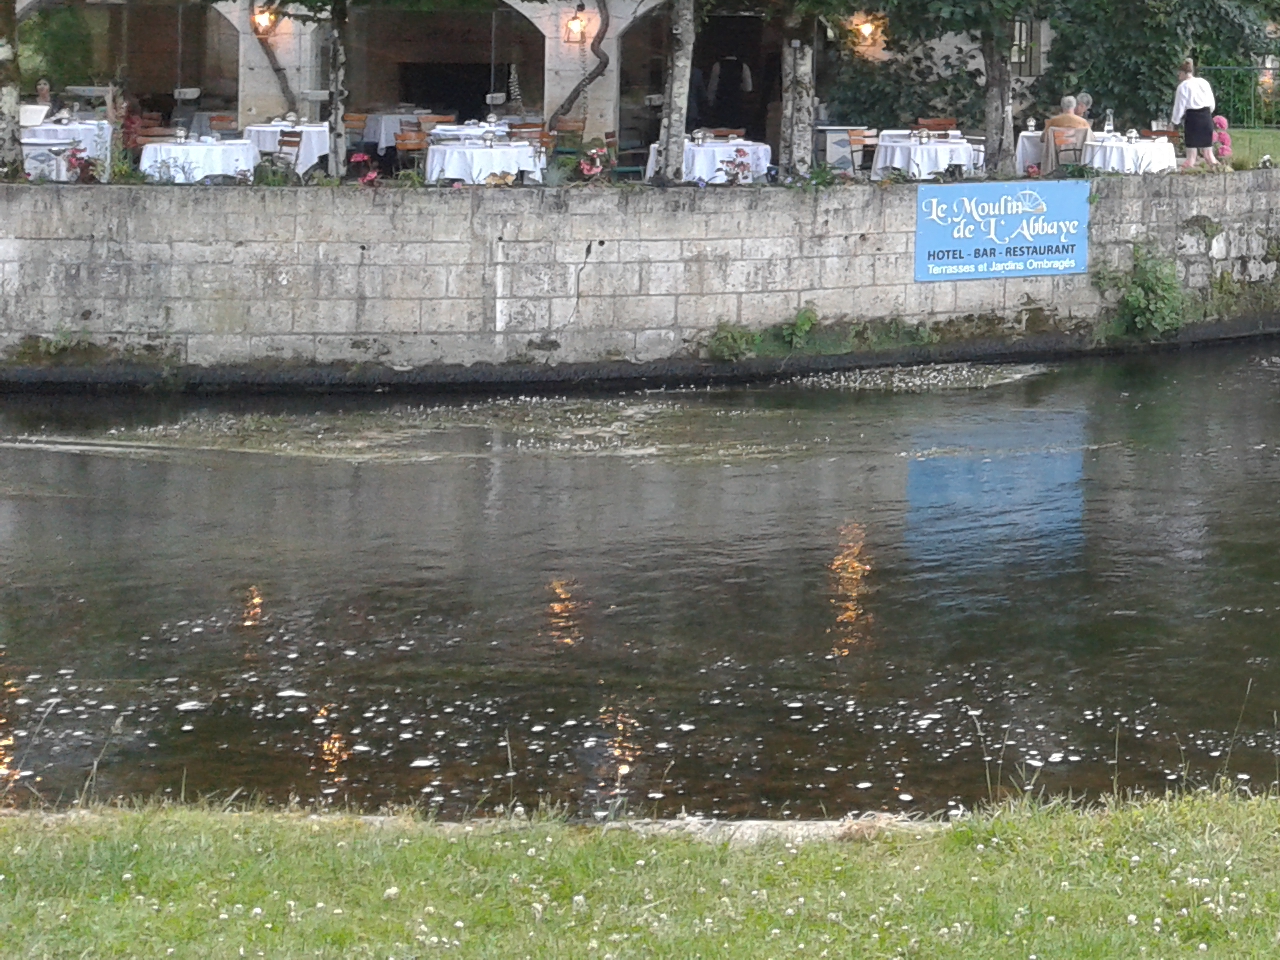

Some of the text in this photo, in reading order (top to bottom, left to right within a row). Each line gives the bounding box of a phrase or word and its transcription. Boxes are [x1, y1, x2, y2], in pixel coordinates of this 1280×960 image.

[922, 196, 1023, 225] Le Moulin
[953, 219, 975, 238] de
[927, 249, 964, 260] HOTEL
[974, 248, 996, 258] BAR
[1005, 244, 1076, 257] RESTAURANT
[928, 258, 1075, 275] Terrasses et Jardins Ombragés
